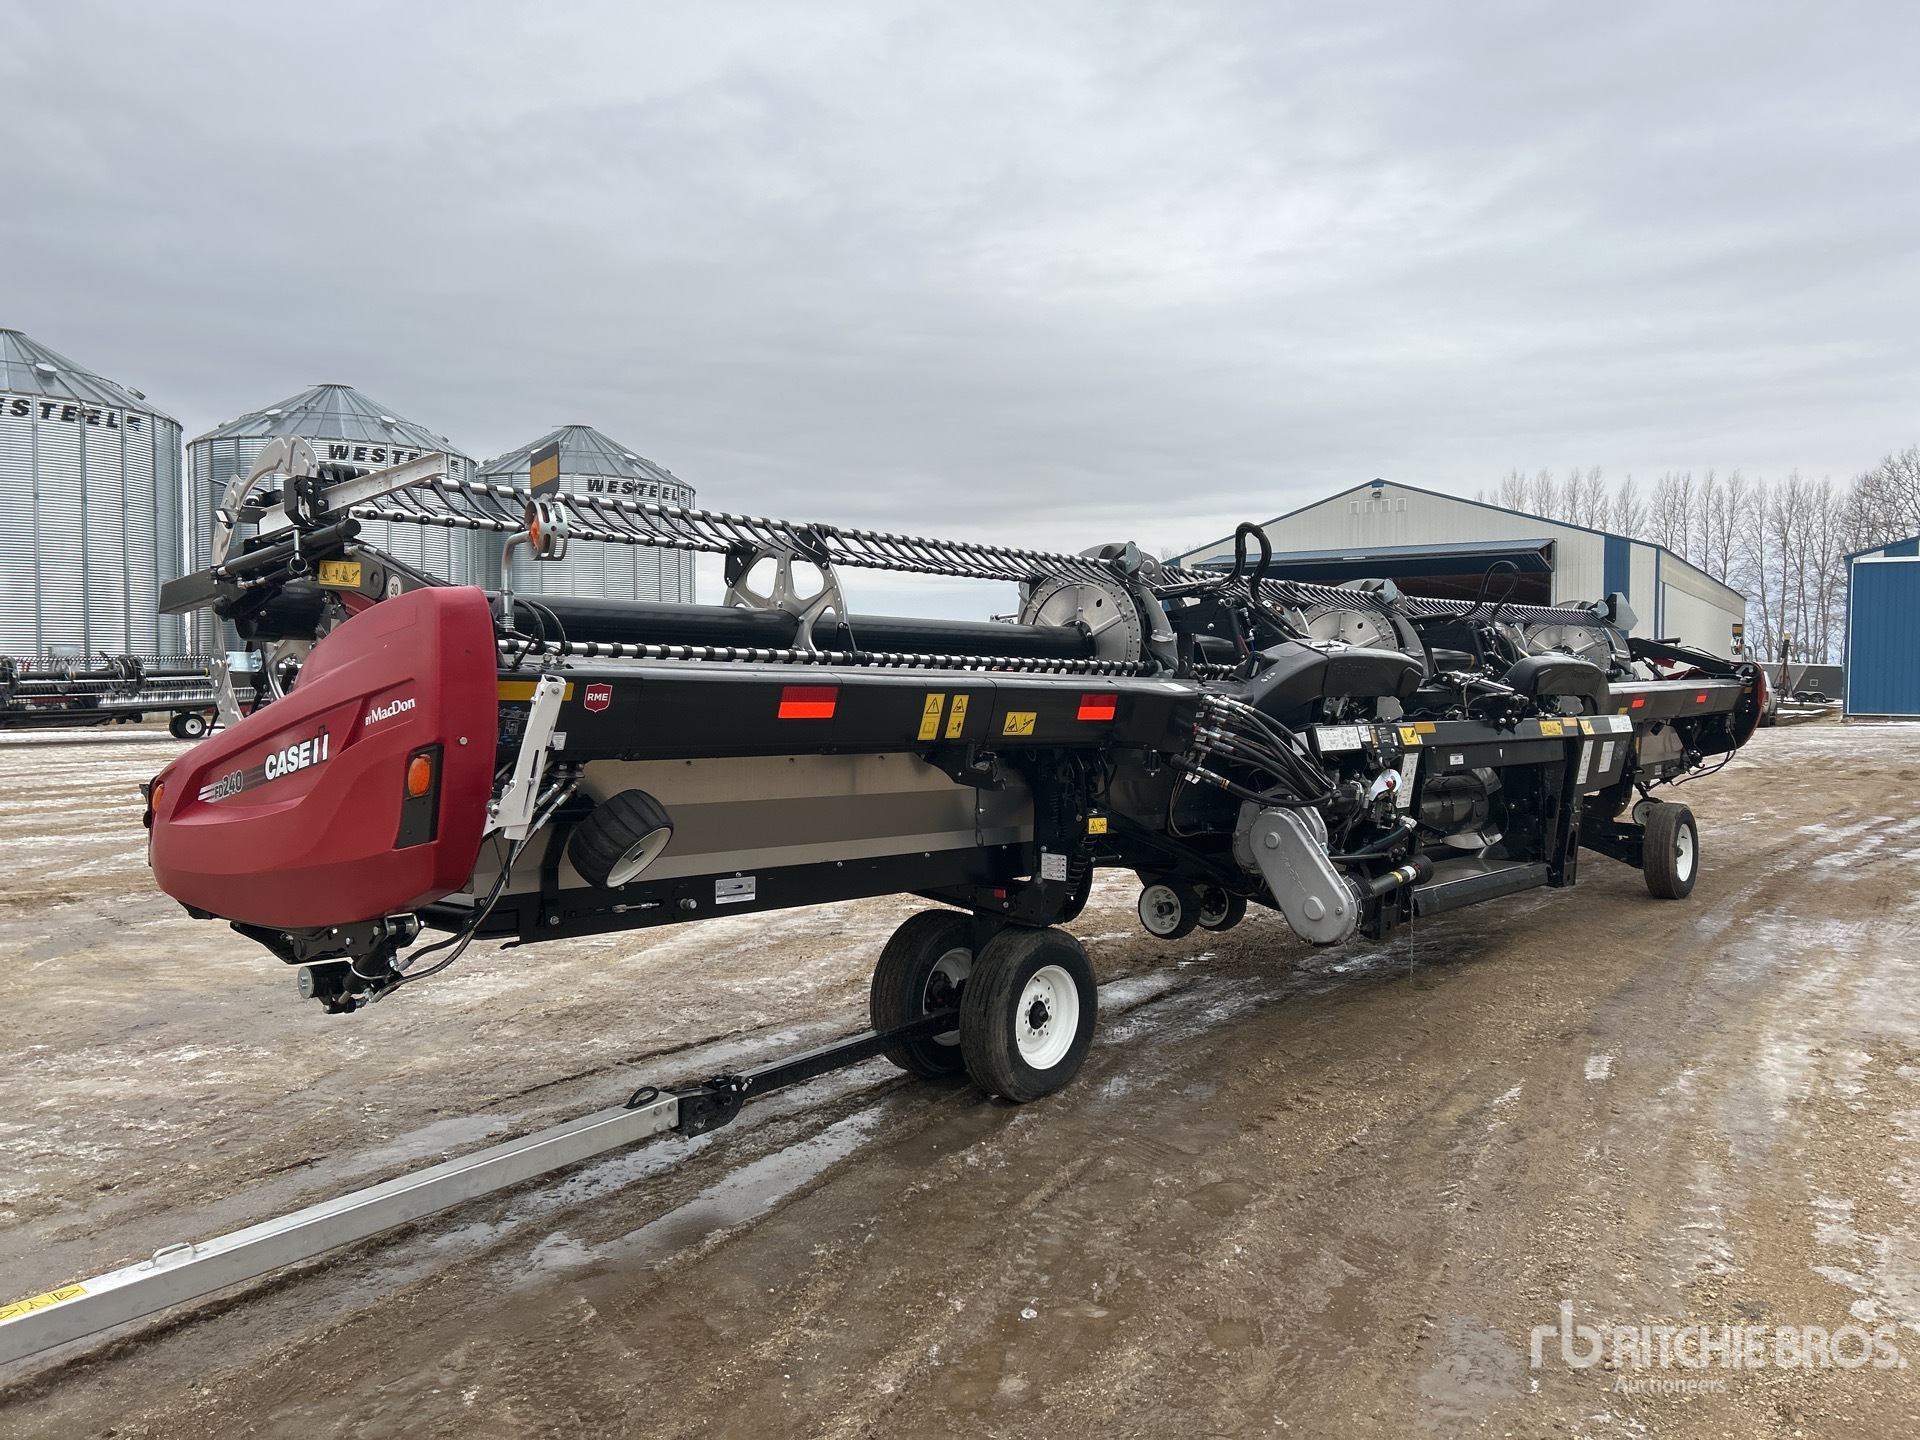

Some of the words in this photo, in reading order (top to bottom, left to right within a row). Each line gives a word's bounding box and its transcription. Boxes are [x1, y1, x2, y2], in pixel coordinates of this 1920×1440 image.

[588, 479, 678, 500] WESTEEL
[390, 583, 399, 595] 30
[587, 693, 609, 701] RME
[371, 698, 416, 723] MacDon
